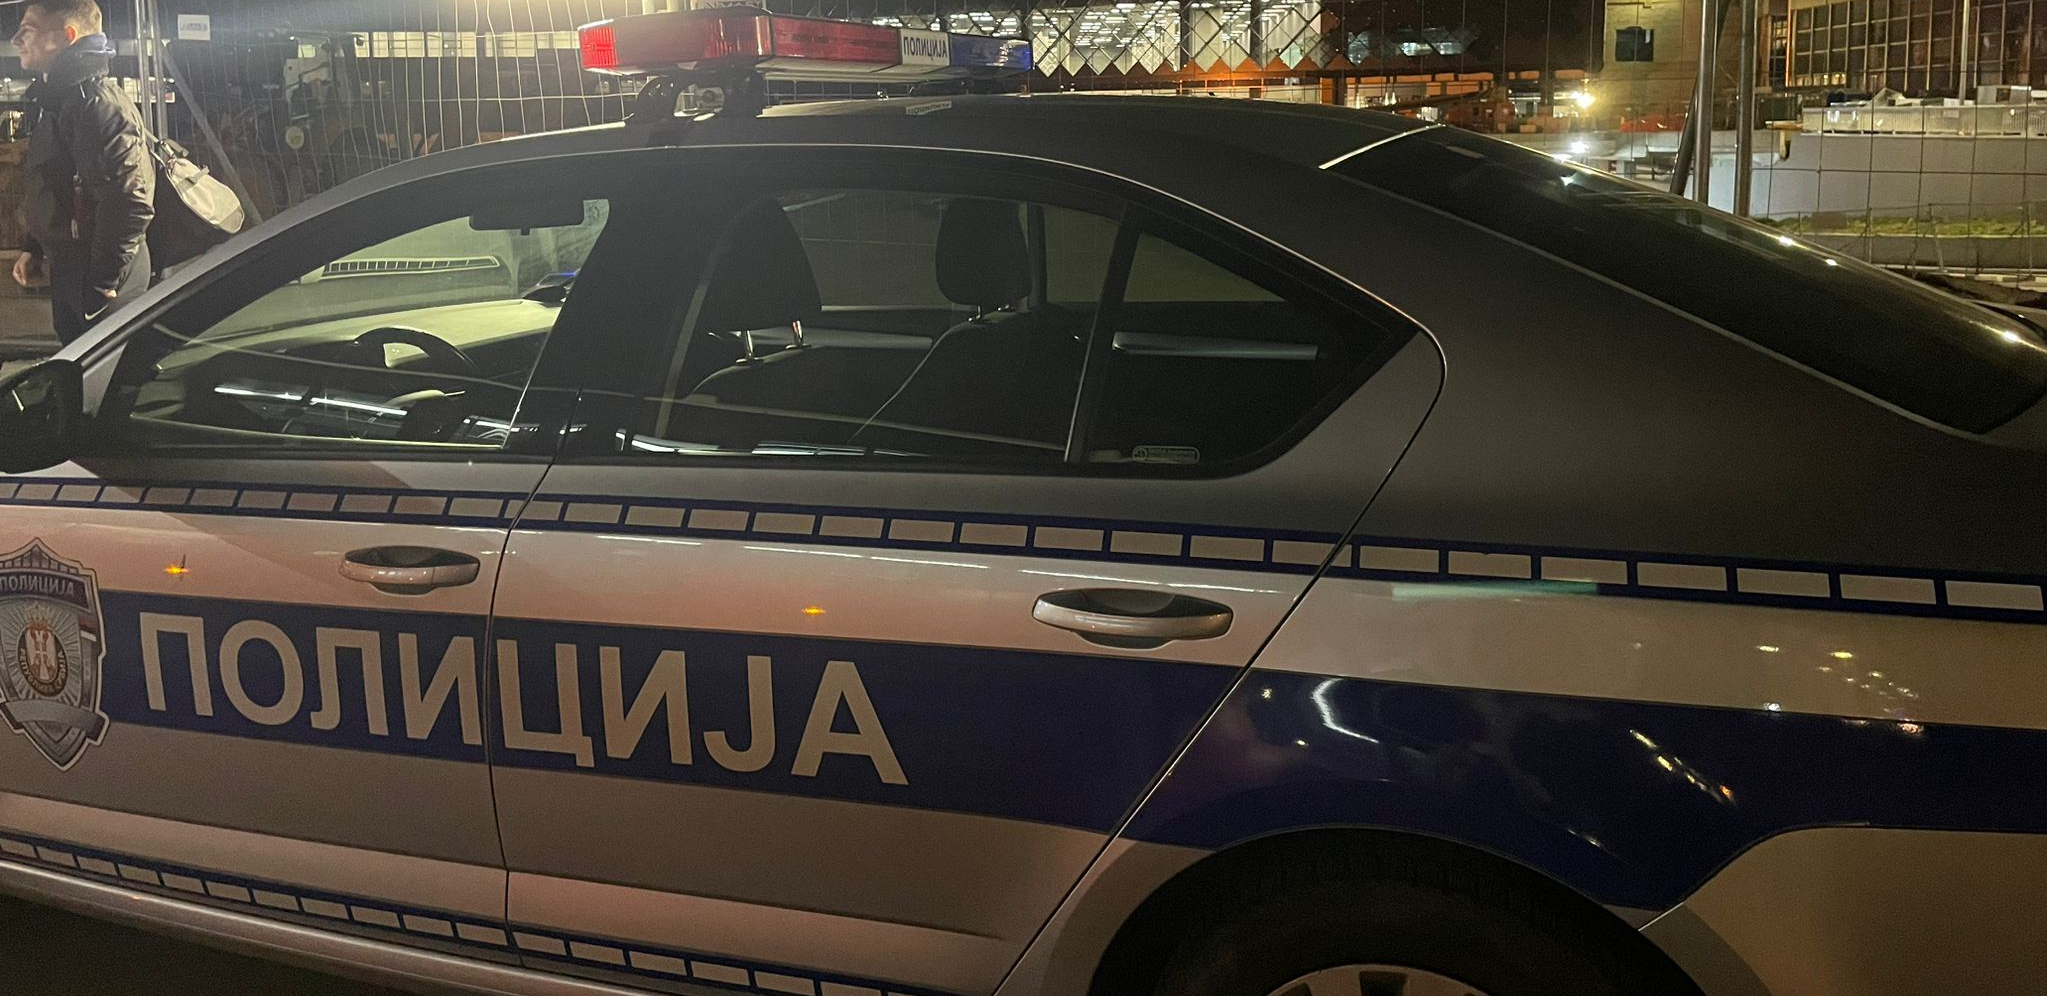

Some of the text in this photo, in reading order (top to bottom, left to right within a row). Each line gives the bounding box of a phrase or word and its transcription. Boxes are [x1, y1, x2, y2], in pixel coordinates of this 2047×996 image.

[903, 37, 948, 61] ПОЛИЦИЈА
[0, 574, 75, 598] ПОЛИЦИЈА
[140, 613, 908, 785] ПОЛИЦИЈА
